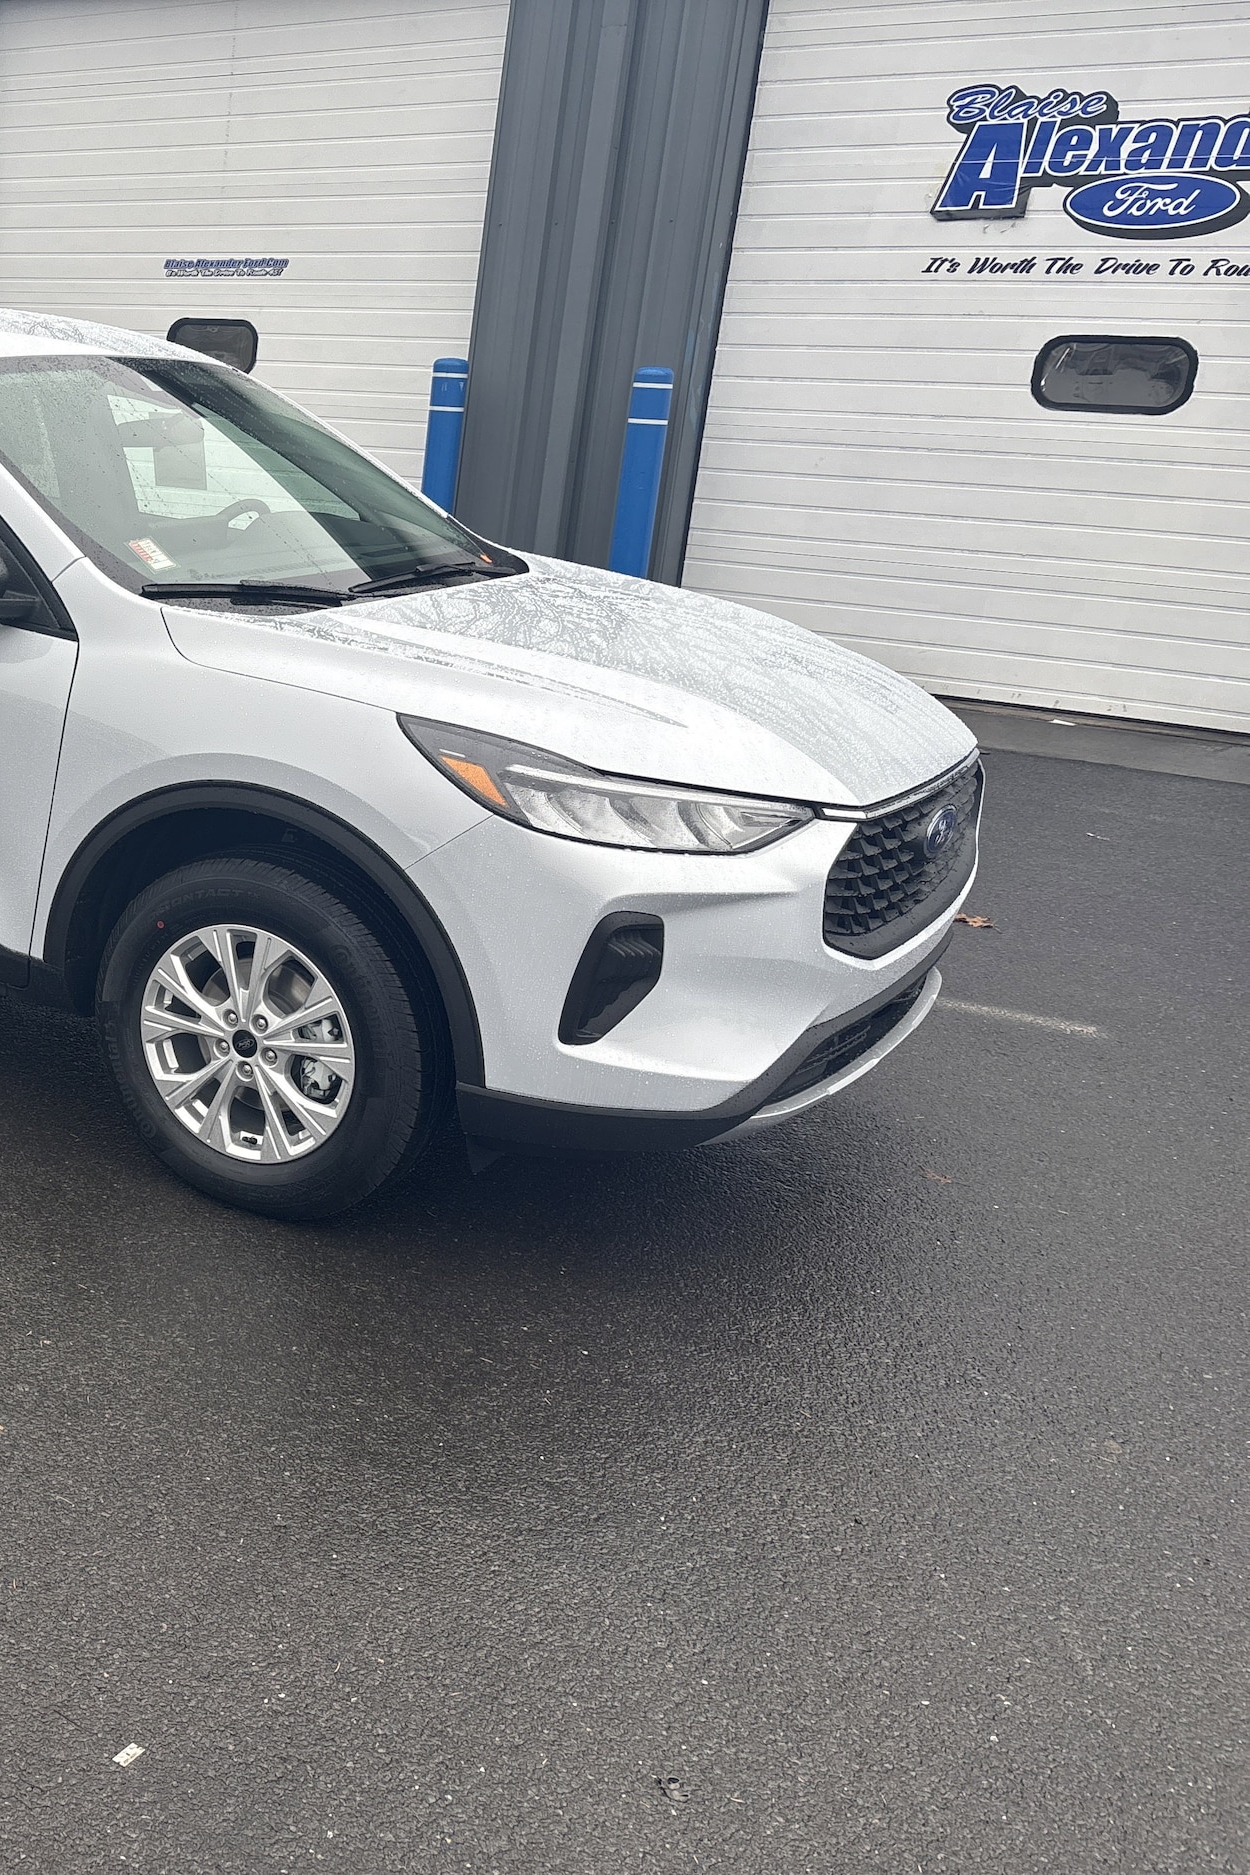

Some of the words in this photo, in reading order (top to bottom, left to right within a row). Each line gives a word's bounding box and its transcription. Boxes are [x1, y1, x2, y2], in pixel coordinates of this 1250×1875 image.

[949, 85, 1110, 122] Blaise
[1103, 182, 1200, 216] Ford
[921, 256, 961, 274] It's
[967, 256, 1038, 275] Worth
[1044, 256, 1084, 275] The
[1093, 256, 1161, 275] Drive
[1168, 258, 1196, 276] To
